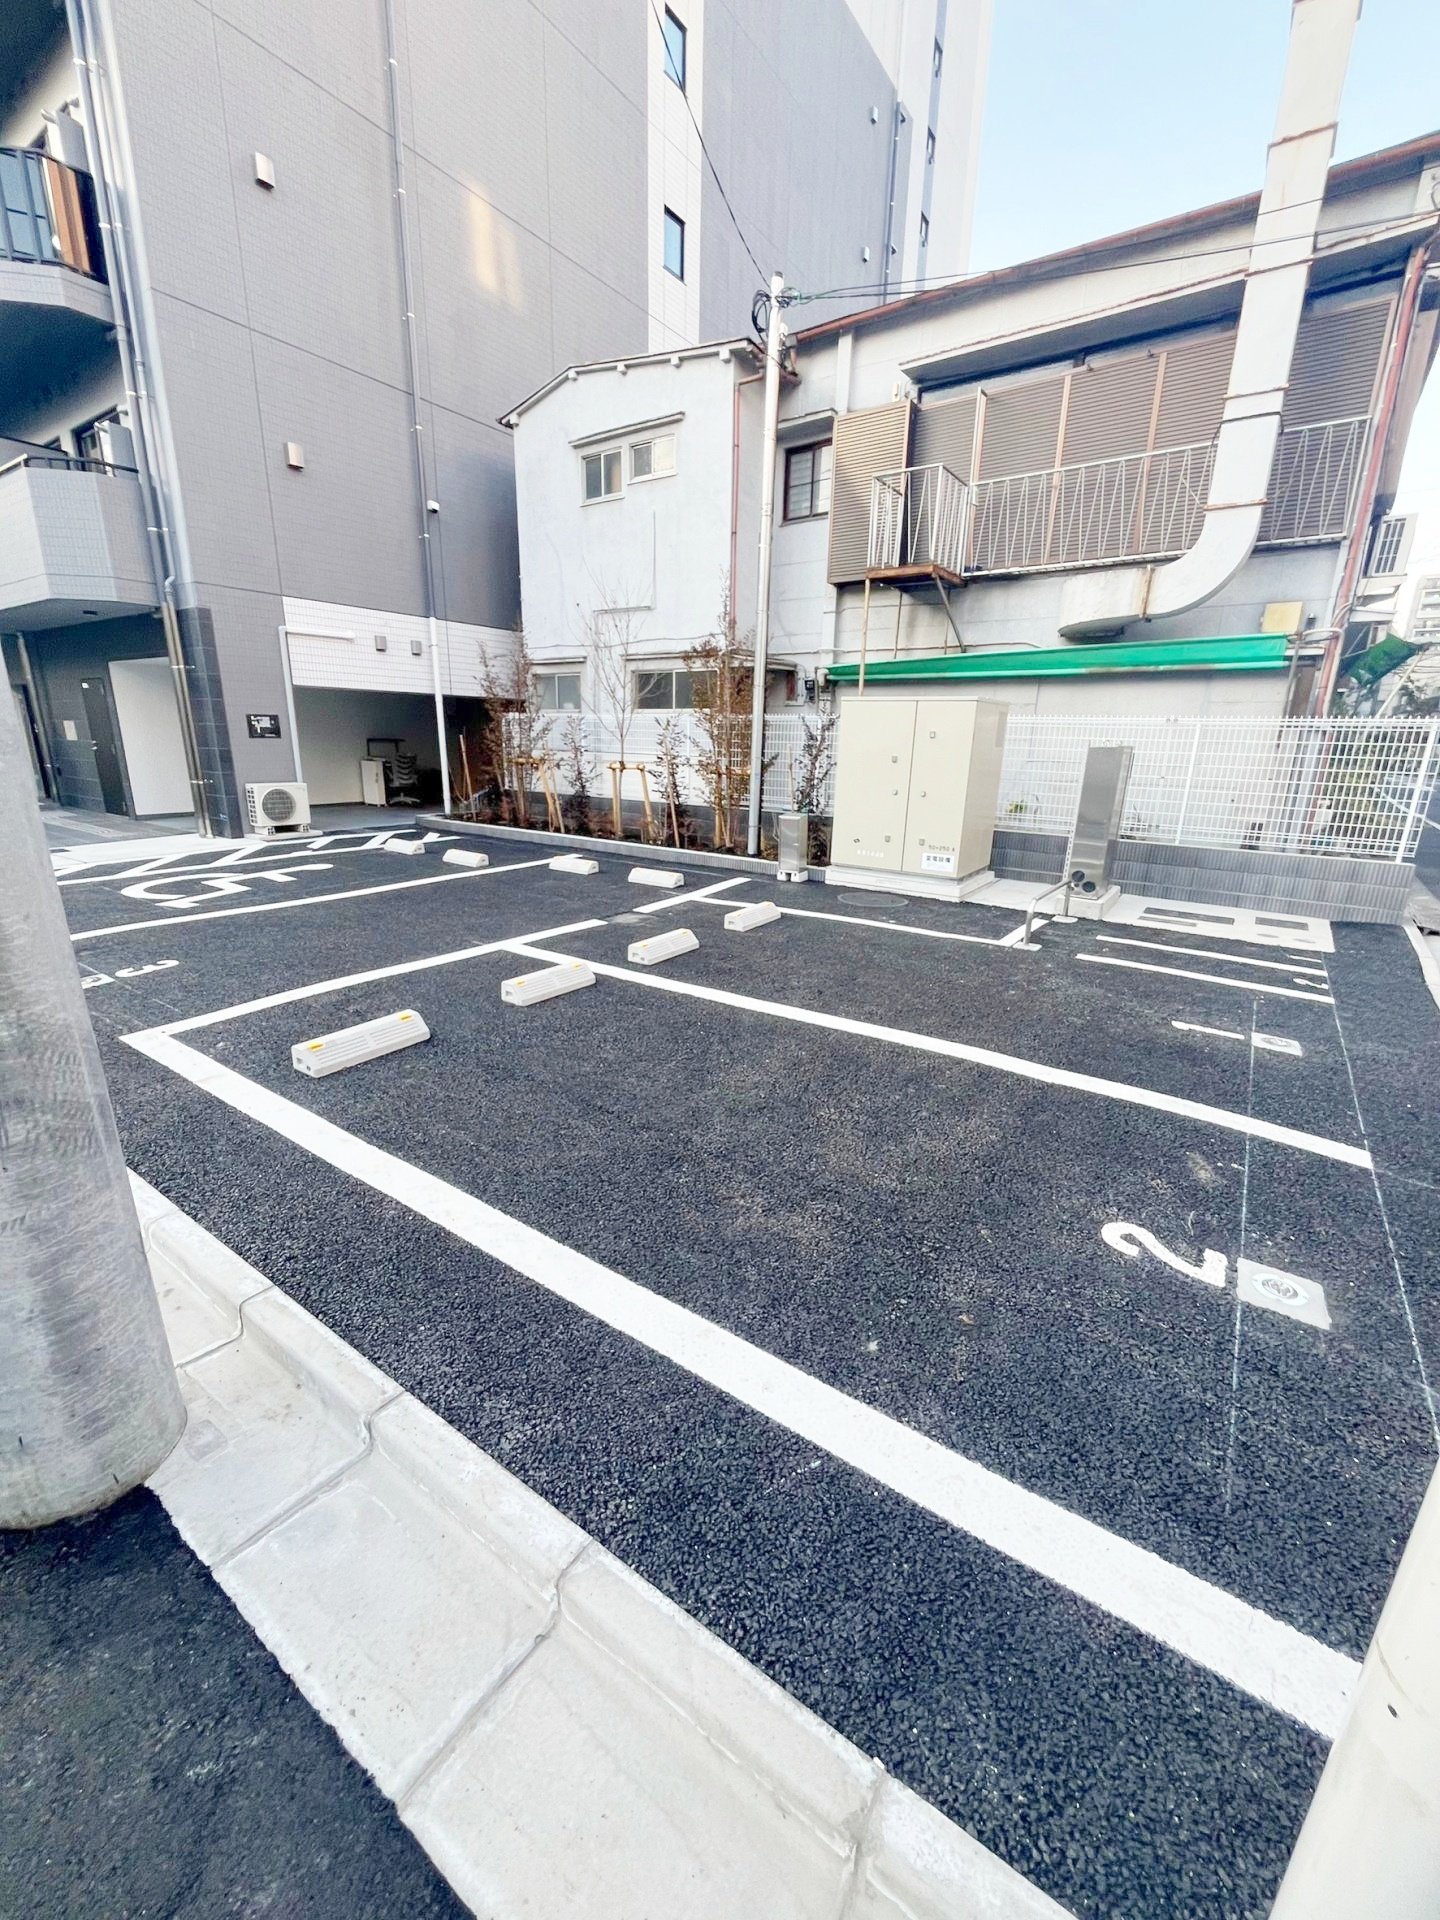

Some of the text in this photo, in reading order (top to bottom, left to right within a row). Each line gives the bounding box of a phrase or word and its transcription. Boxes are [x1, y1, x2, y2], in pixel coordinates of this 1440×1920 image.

[115, 959, 180, 978] 3
[1293, 977, 1330, 990] 2
[1100, 1221, 1229, 1288] 2
